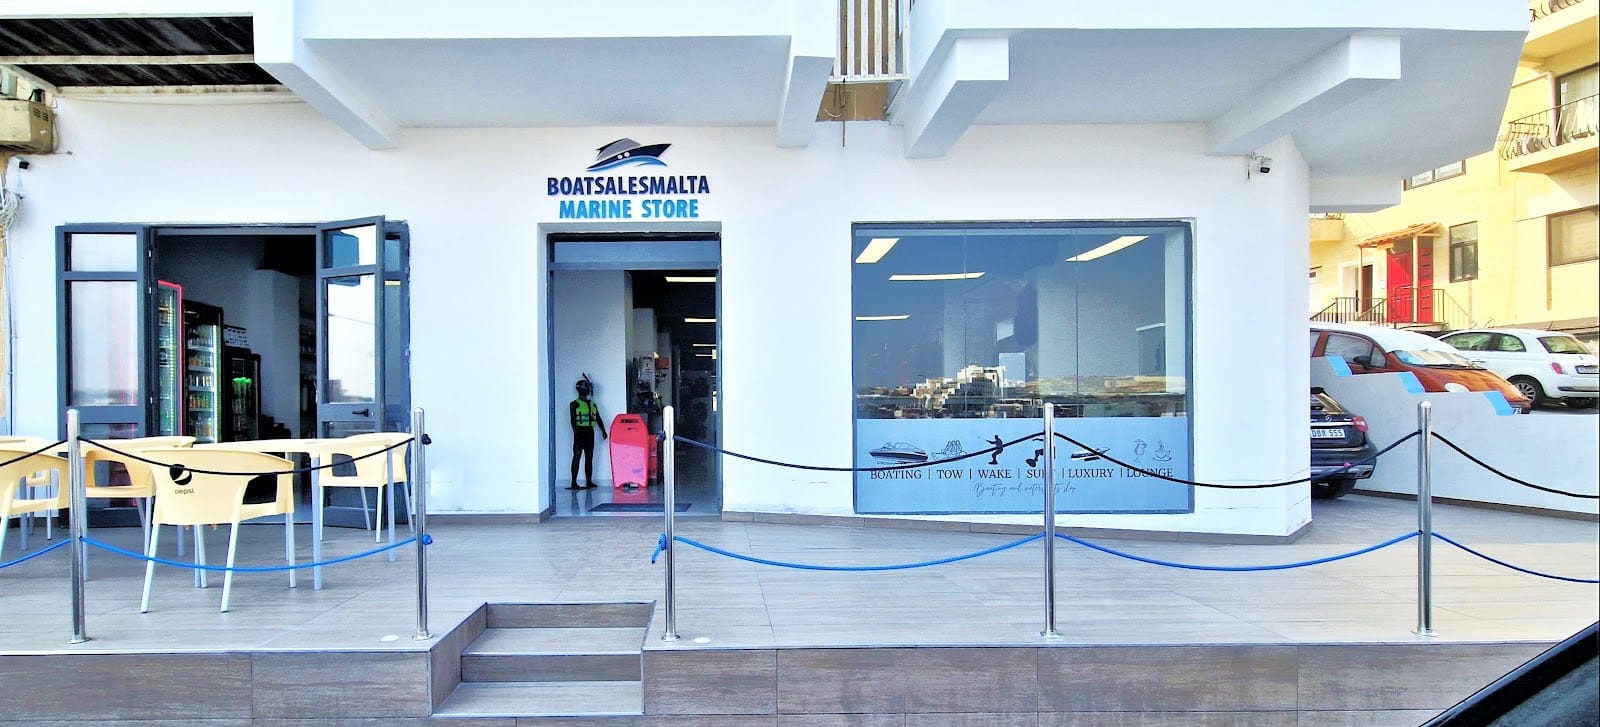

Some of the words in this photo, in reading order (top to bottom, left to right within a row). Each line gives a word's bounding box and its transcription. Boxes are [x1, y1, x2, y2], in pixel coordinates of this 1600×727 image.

[547, 175, 710, 196] BOATSALESMALTA
[559, 200, 632, 219] MARINE
[641, 199, 699, 218] STORE
[870, 469, 922, 480] BOATING
[936, 469, 963, 479] TOW
[978, 469, 1012, 479] WAKE
[1068, 468, 1114, 478] LUXURY
